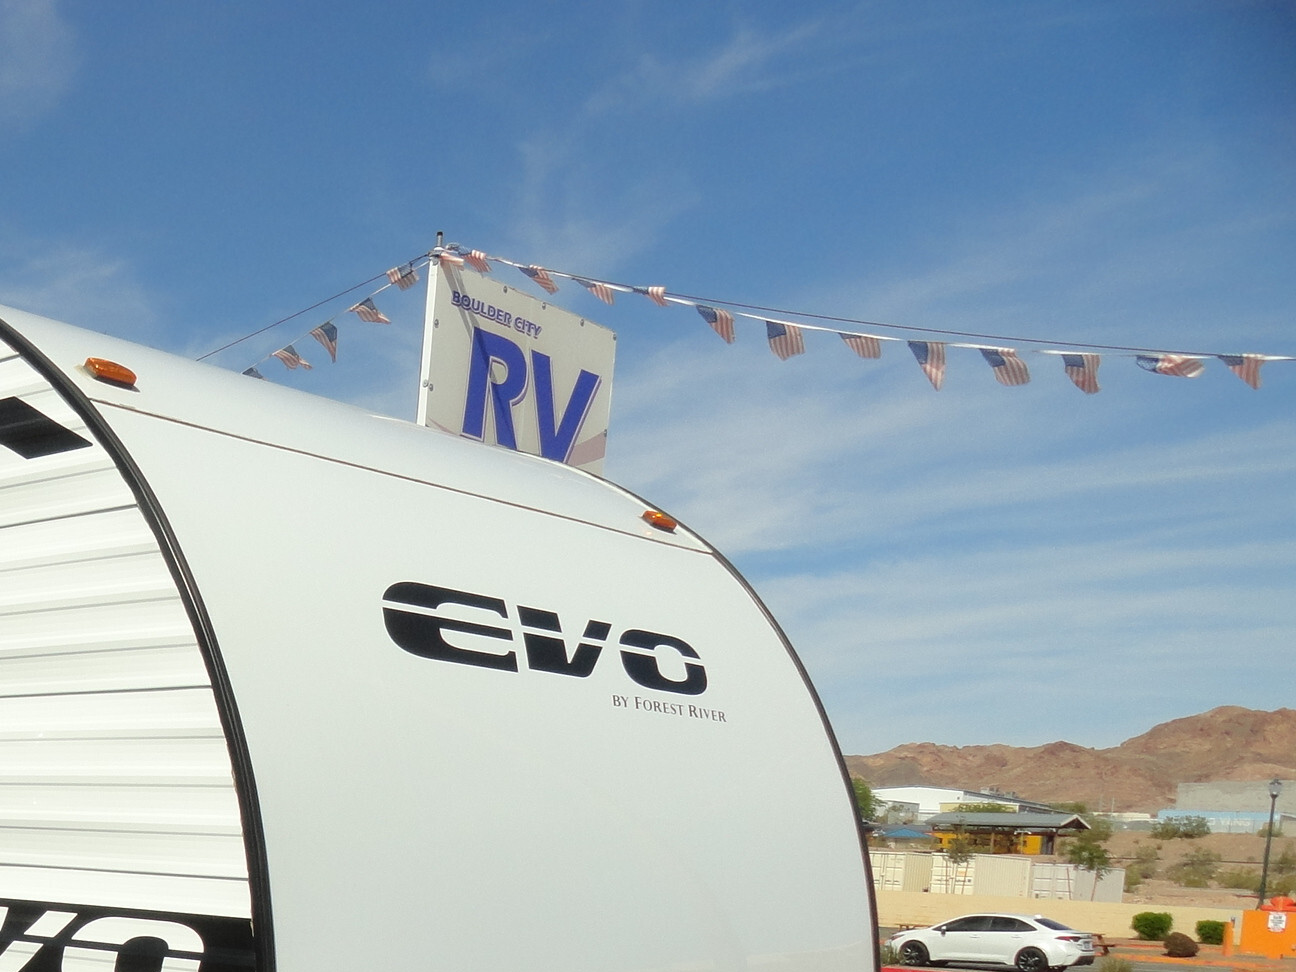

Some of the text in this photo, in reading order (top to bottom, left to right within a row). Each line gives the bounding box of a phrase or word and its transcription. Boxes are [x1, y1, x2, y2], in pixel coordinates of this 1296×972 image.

[451, 291, 542, 339] BOULDER CITY
[460, 326, 602, 463] RV
[382, 581, 708, 696] EVO
[612, 694, 727, 723] BY FOREST RIVER
